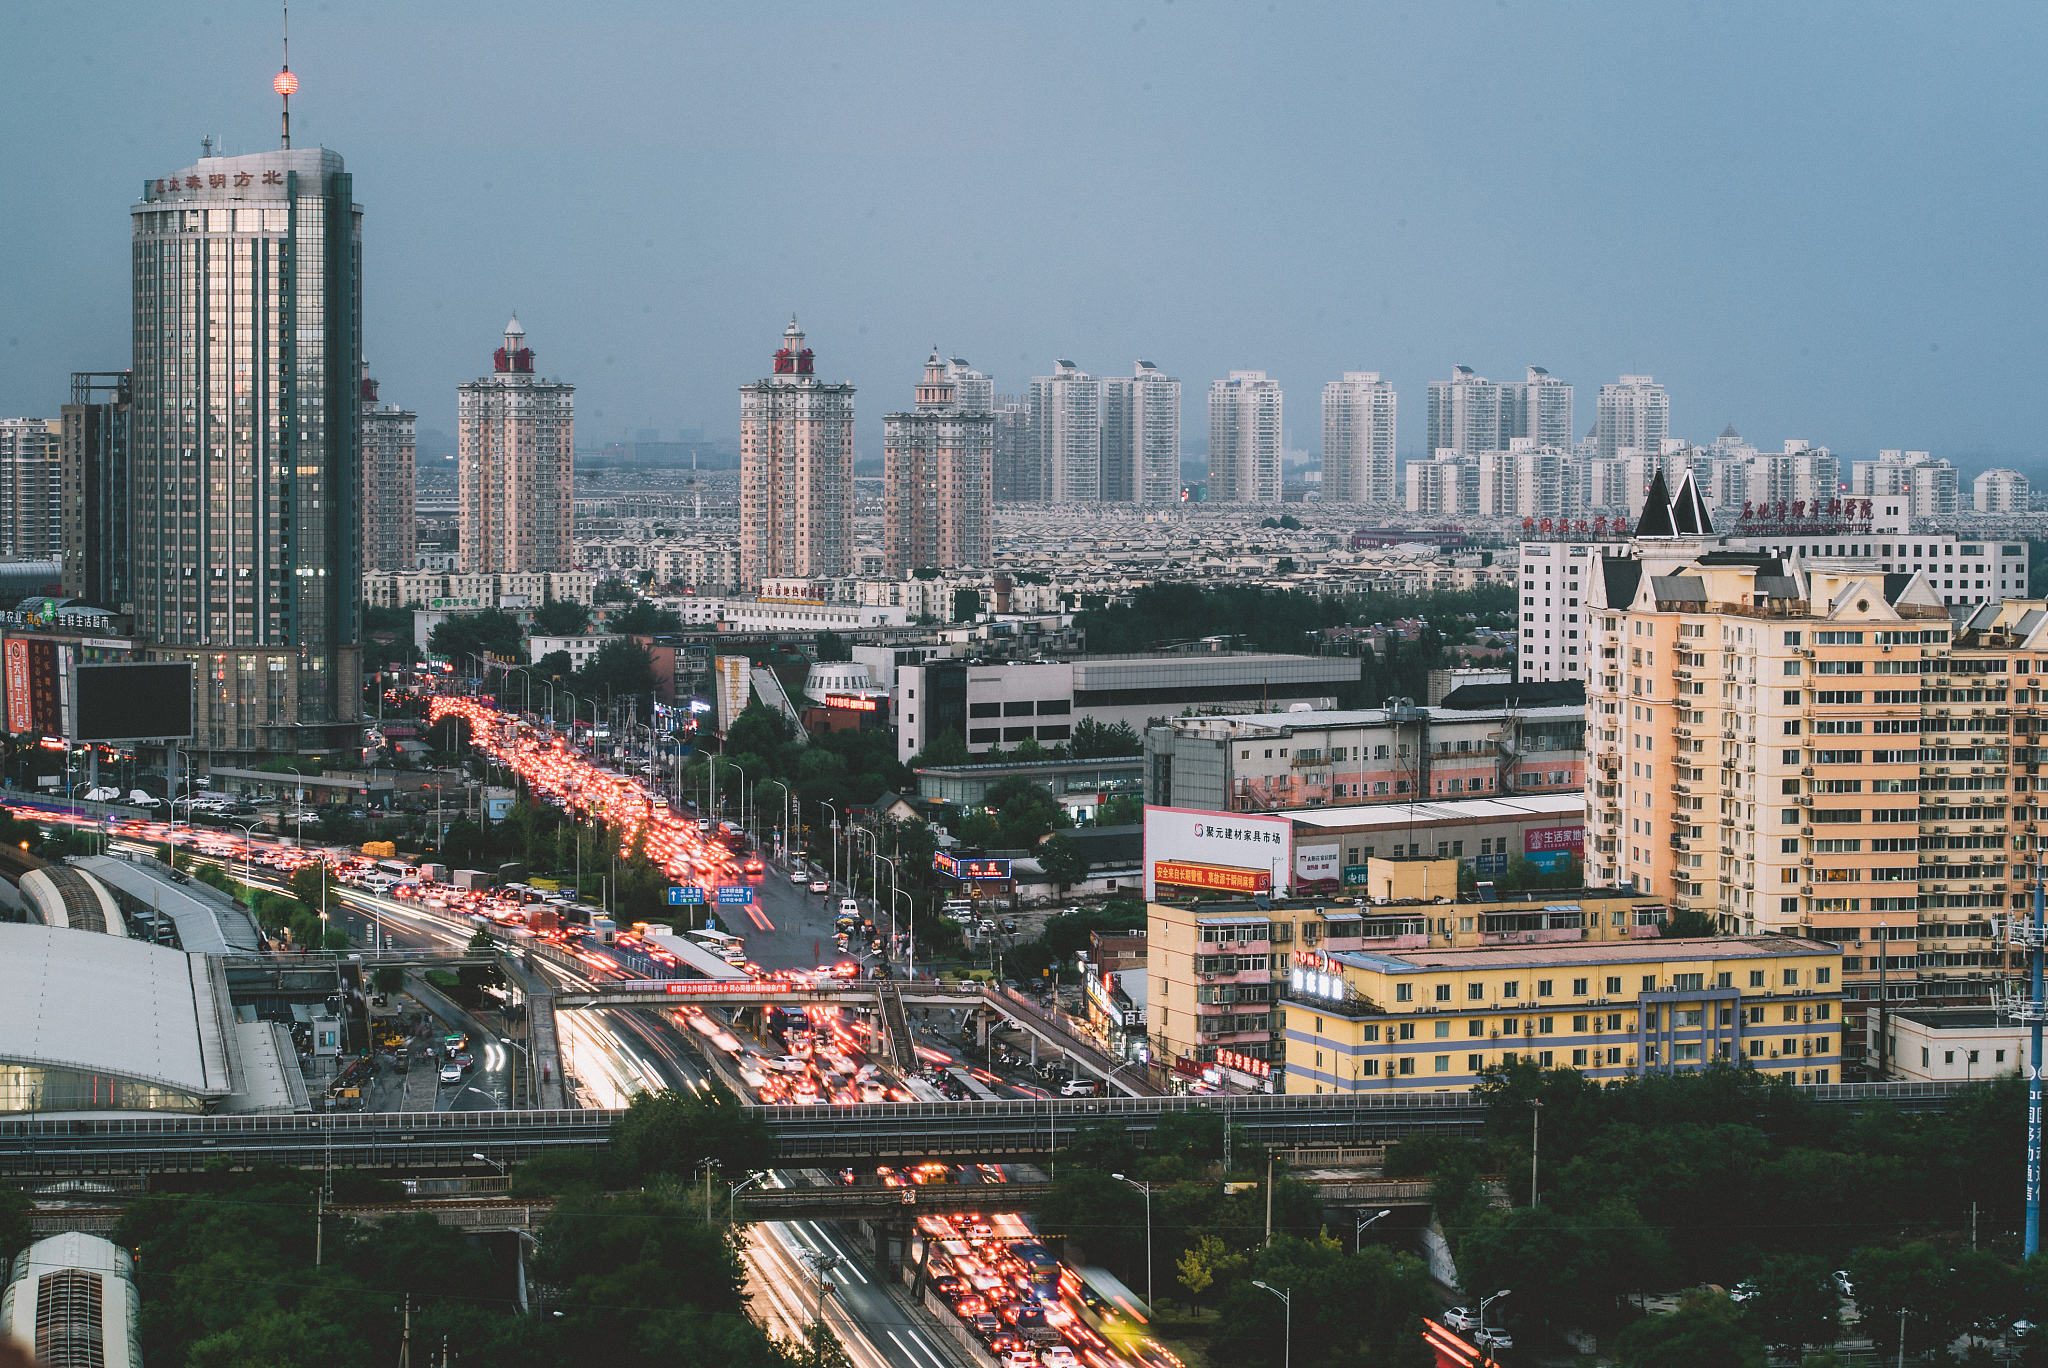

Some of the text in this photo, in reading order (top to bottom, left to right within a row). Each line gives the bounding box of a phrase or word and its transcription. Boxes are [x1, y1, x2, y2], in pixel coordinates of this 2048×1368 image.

[1740, 497, 1874, 521] 石化管理干部学院
[1522, 515, 1628, 534] 中国石化党校
[44, 602, 53, 618] 菜
[59, 614, 109, 628] 生鲜生活超市
[1206, 825, 1280, 844] 聚元建材家具市场
[1216, 1048, 1270, 1078] 世纪华联超市
